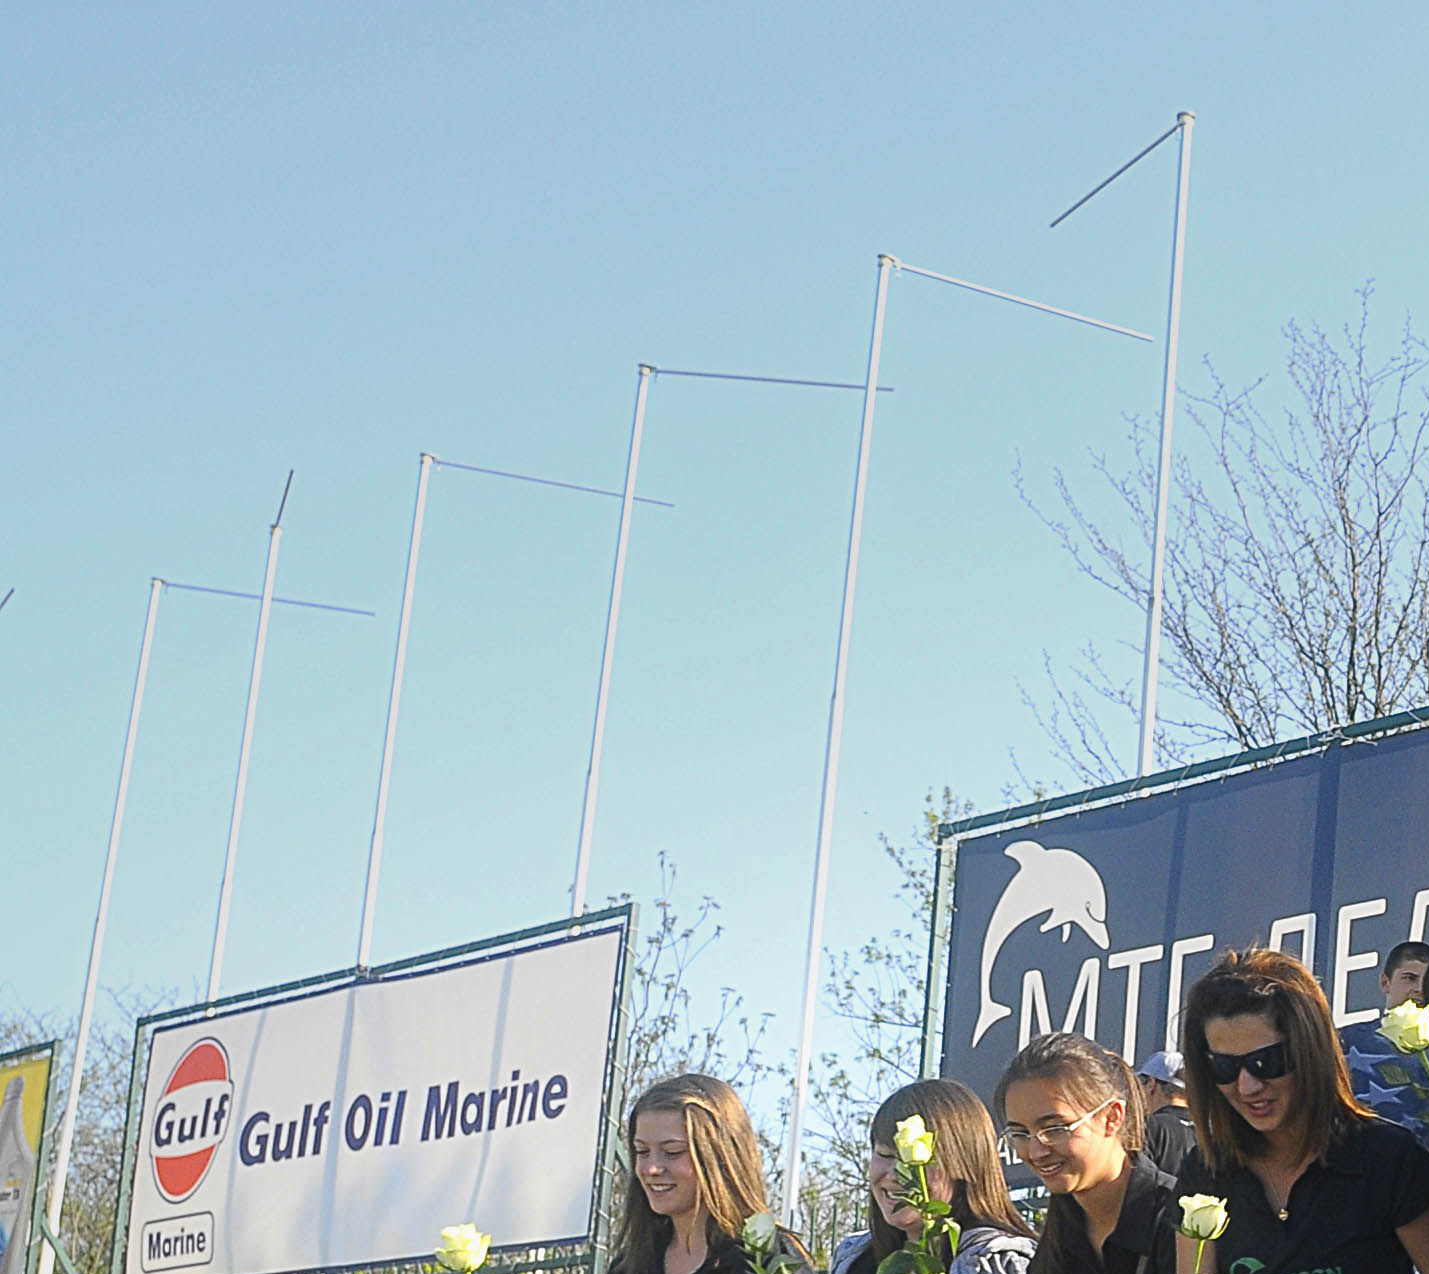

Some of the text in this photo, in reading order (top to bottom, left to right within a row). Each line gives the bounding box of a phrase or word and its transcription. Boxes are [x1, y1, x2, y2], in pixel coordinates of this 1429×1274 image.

[153, 1092, 230, 1149] Gulf
[239, 1069, 569, 1167] Gulf Oil Marine
[147, 1227, 206, 1260] Marine
